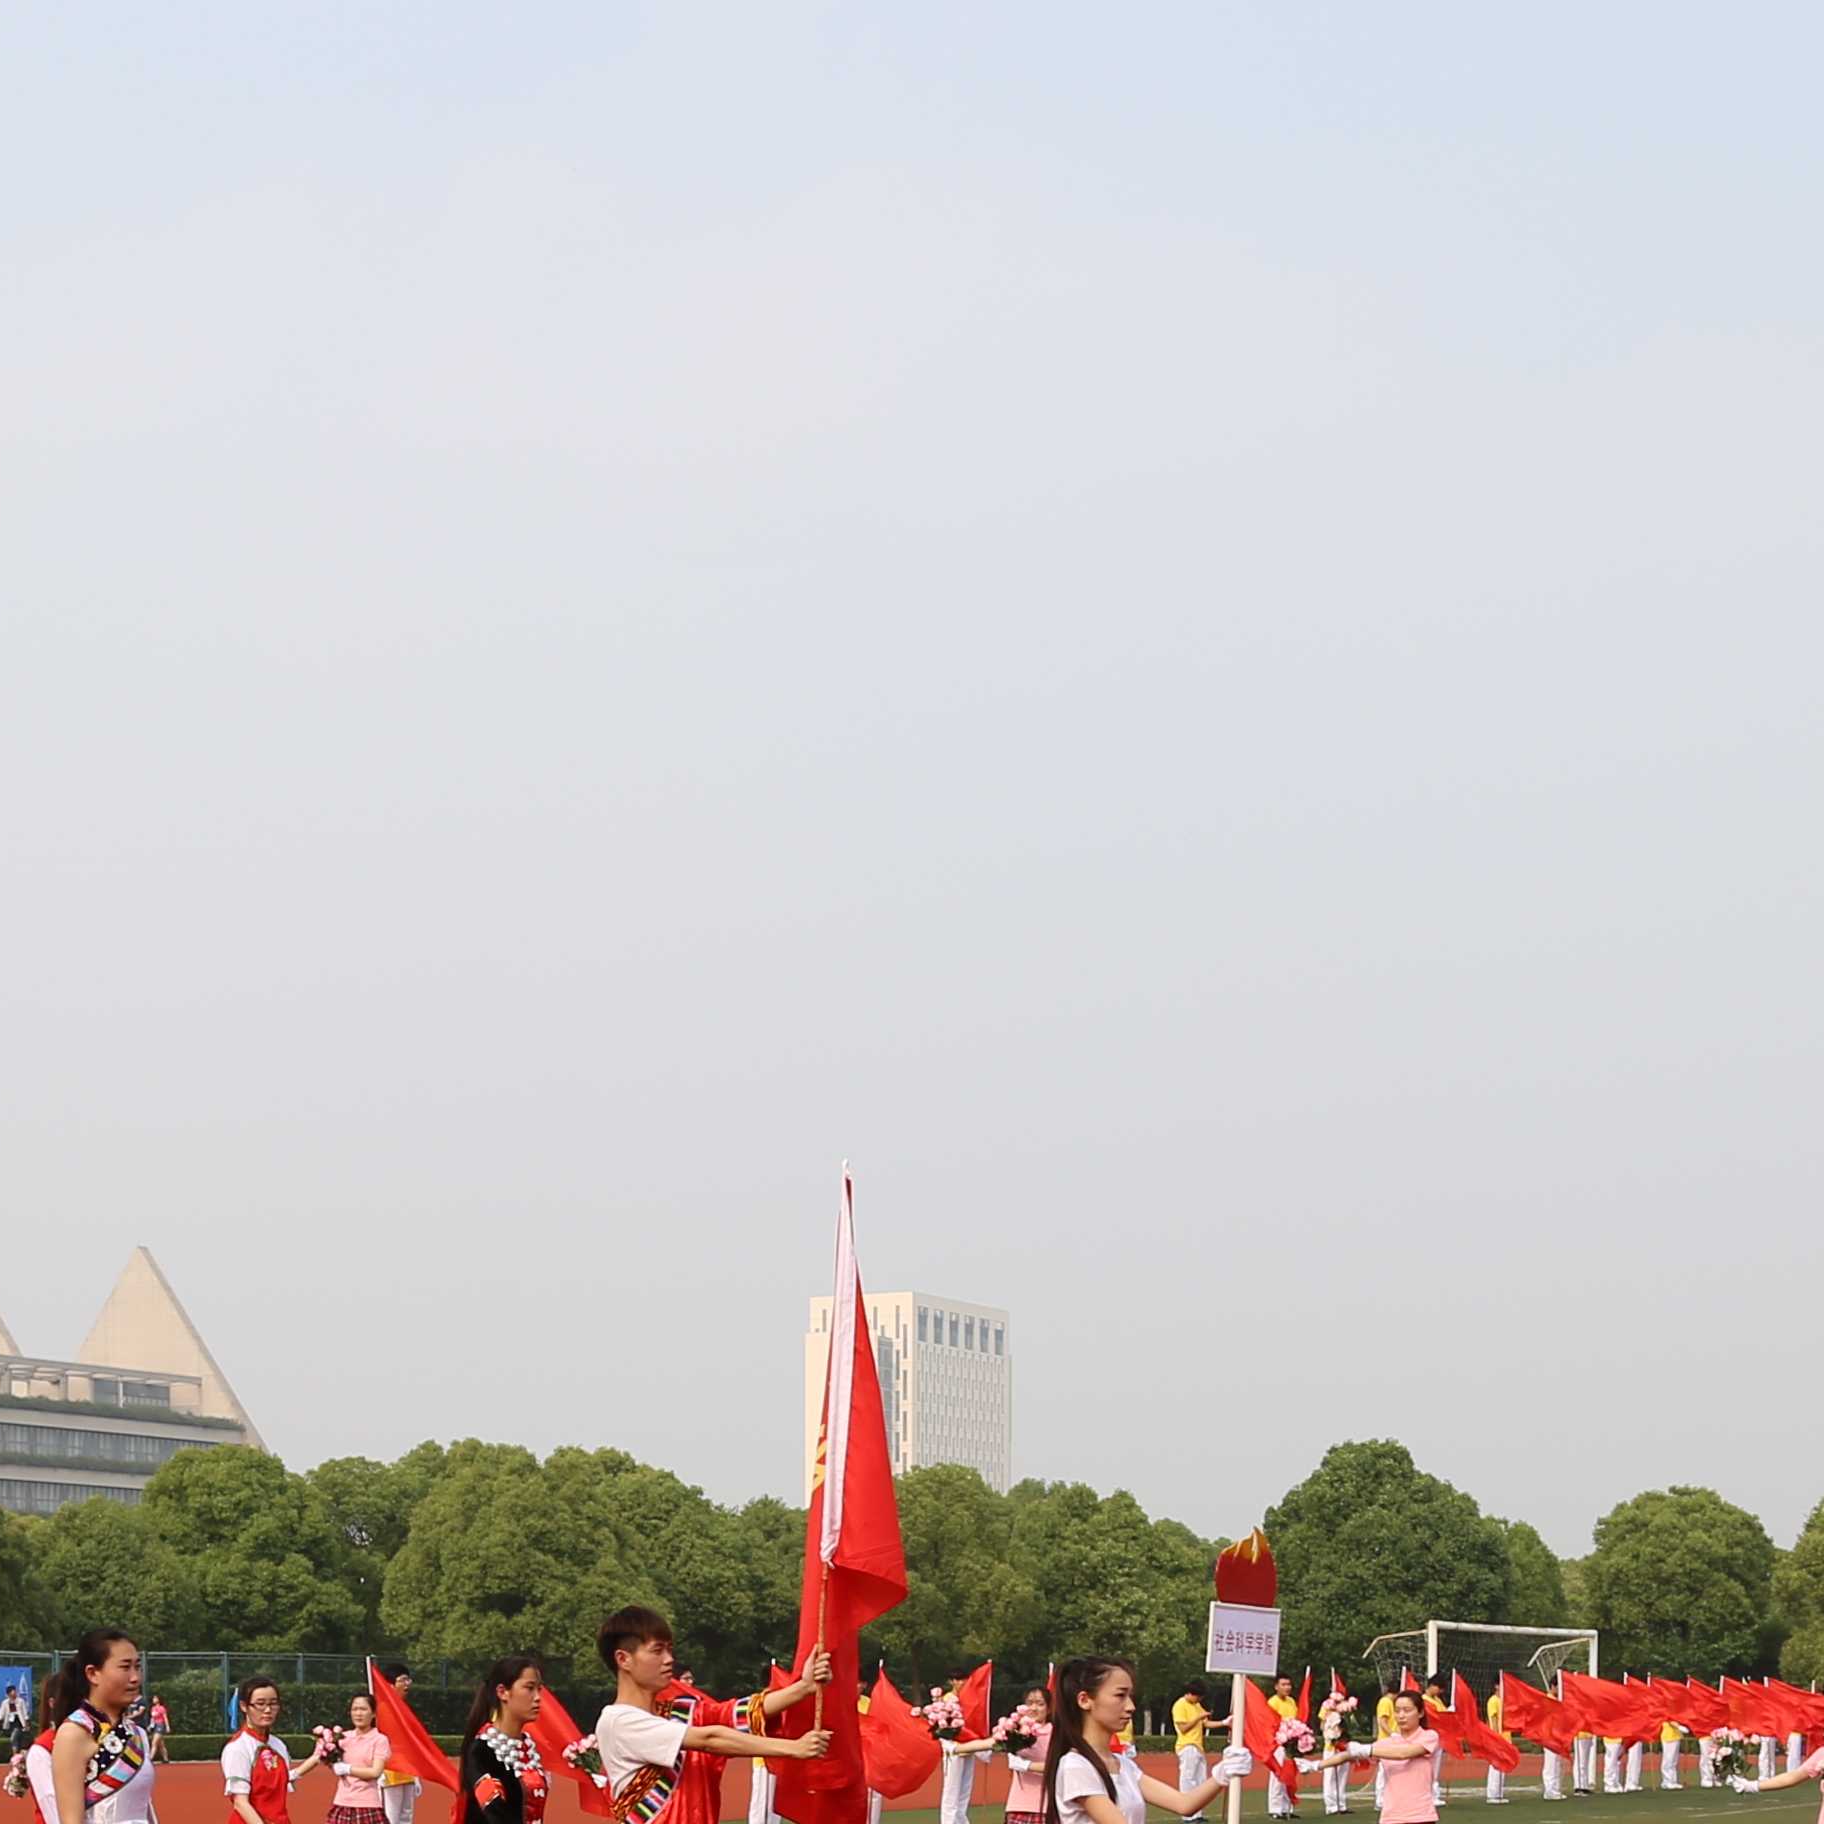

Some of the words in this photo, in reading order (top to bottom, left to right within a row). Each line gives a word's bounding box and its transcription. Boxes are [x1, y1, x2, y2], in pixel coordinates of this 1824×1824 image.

[1215, 1629, 1273, 1656] 社会科学学院
